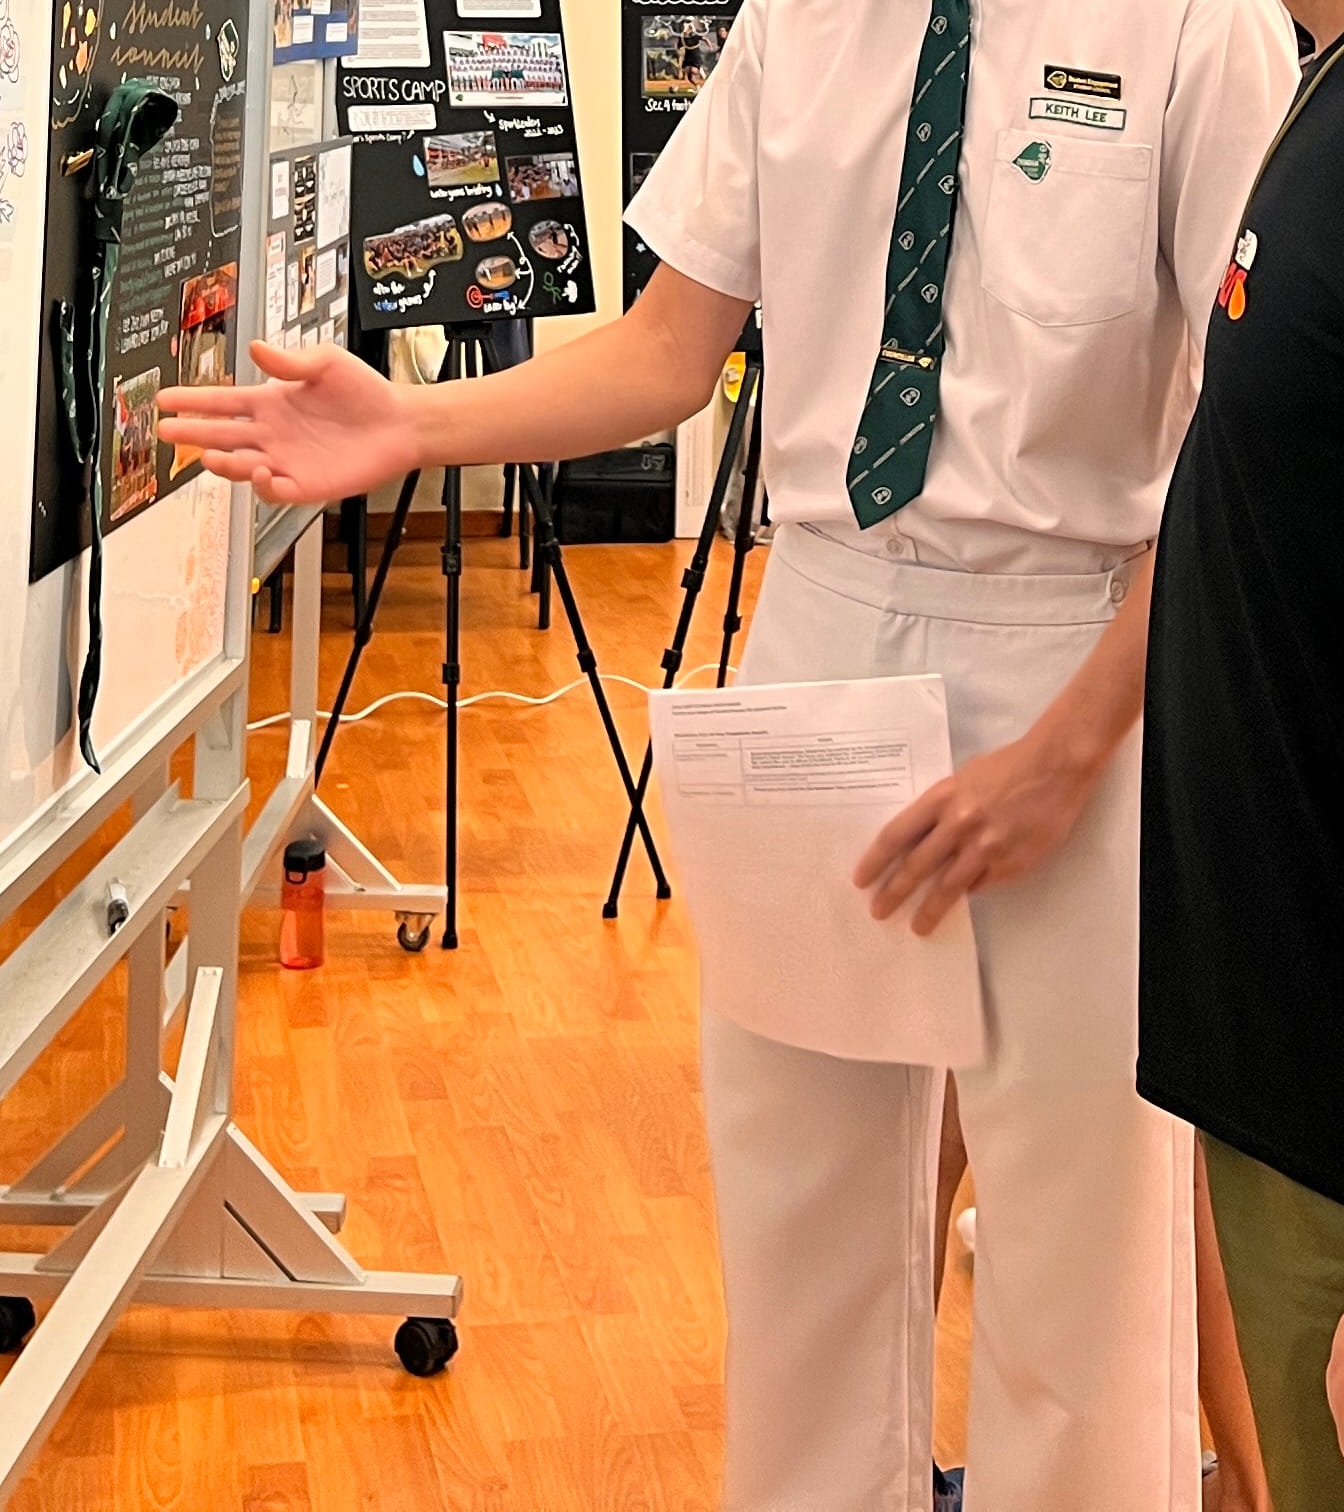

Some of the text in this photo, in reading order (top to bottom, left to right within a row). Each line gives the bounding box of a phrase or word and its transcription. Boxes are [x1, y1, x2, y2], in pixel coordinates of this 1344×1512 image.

[342, 75, 446, 103] SPORTS CAMP
[645, 98, 663, 112] Sec
[1045, 103, 1107, 123] KEITH LEE
